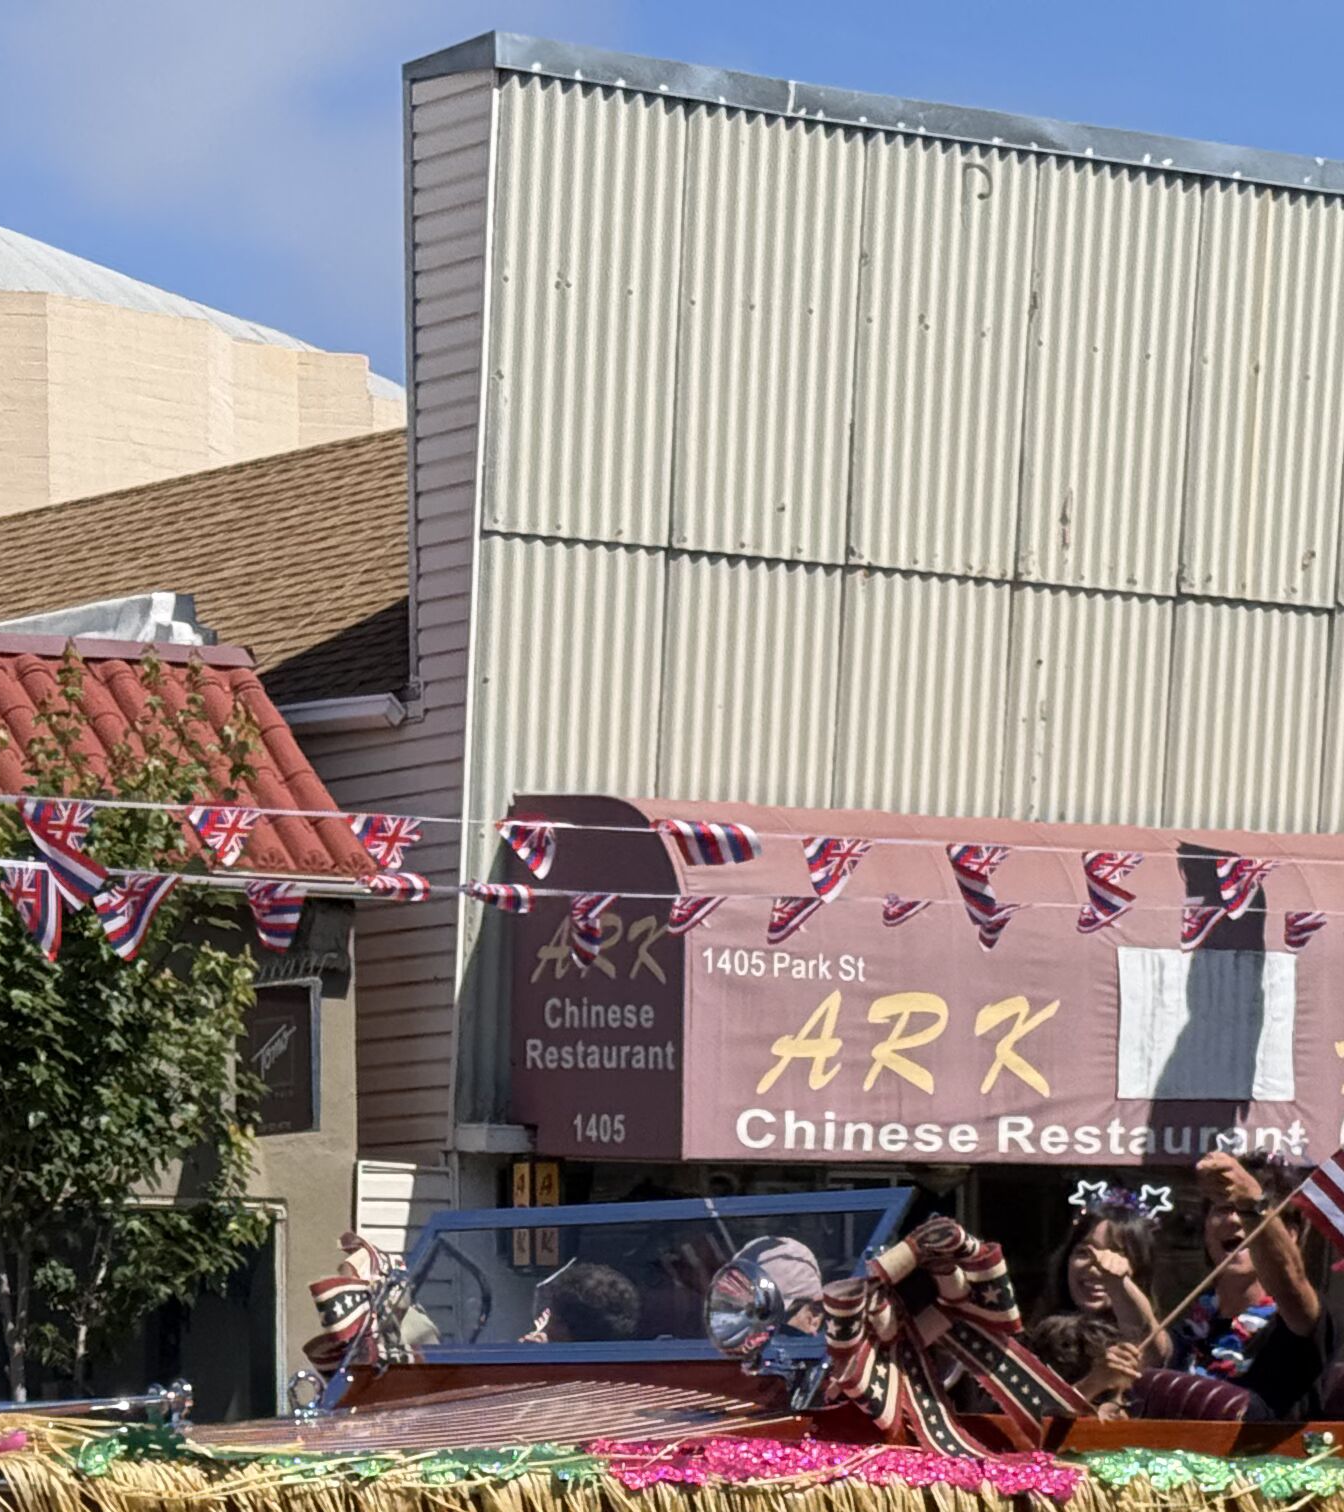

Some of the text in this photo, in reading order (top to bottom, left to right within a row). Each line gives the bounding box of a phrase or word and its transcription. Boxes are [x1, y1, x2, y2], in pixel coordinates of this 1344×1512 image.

[530, 912, 669, 985] ARK
[702, 947, 867, 983] 1405 Park St
[543, 996, 655, 1031] Chinese
[525, 1037, 676, 1071] Restaurant
[756, 988, 1062, 1099] ARK
[572, 1112, 626, 1144] 1405
[735, 1107, 980, 1154] Chinese
[997, 1114, 1308, 1157] Restaurant
